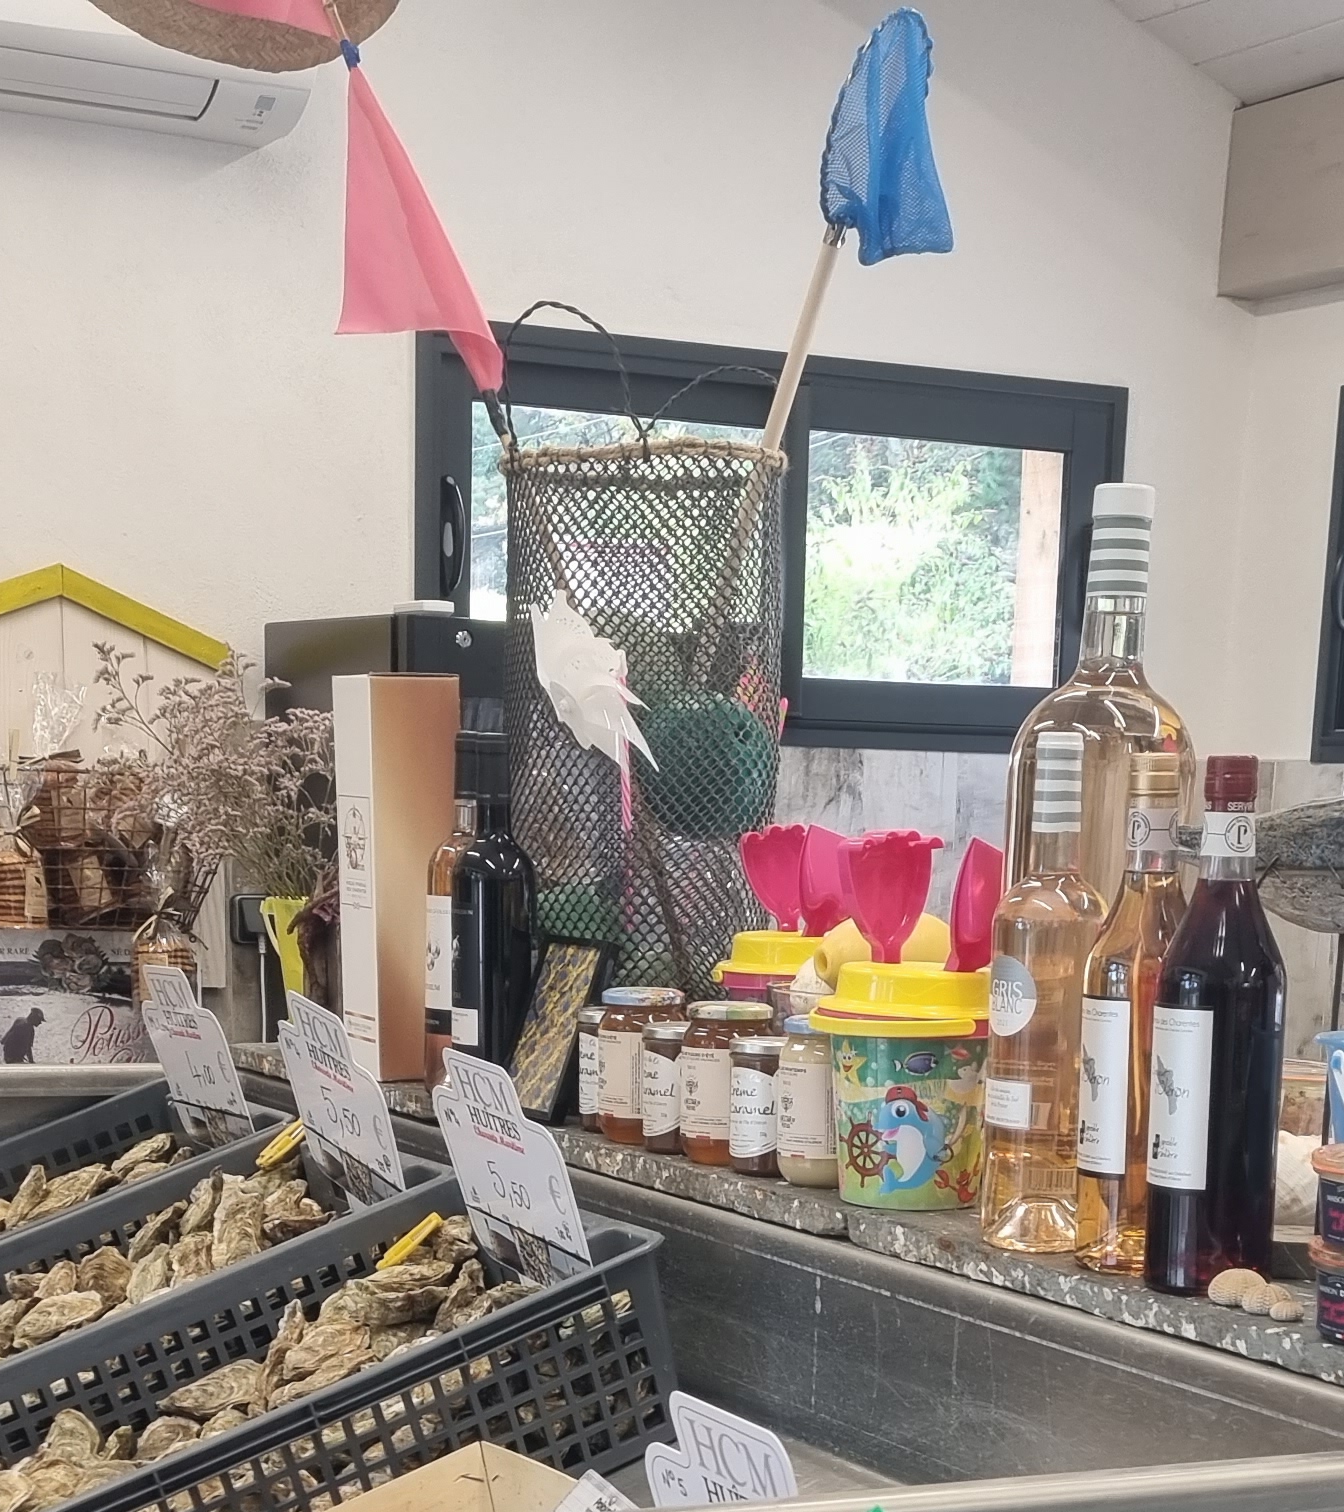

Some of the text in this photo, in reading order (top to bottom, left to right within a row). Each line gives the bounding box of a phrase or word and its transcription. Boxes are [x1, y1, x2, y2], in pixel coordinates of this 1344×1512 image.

[151, 979, 190, 1010] HCM
[990, 997, 1024, 1015] BLANC
[991, 978, 1024, 1000] GRIS
[296, 1007, 346, 1060] HCM
[319, 1085, 362, 1138] 5,50
[453, 1065, 515, 1116] HCM
[485, 1160, 531, 1211] 5,50
[684, 1416, 778, 1498] HCM
